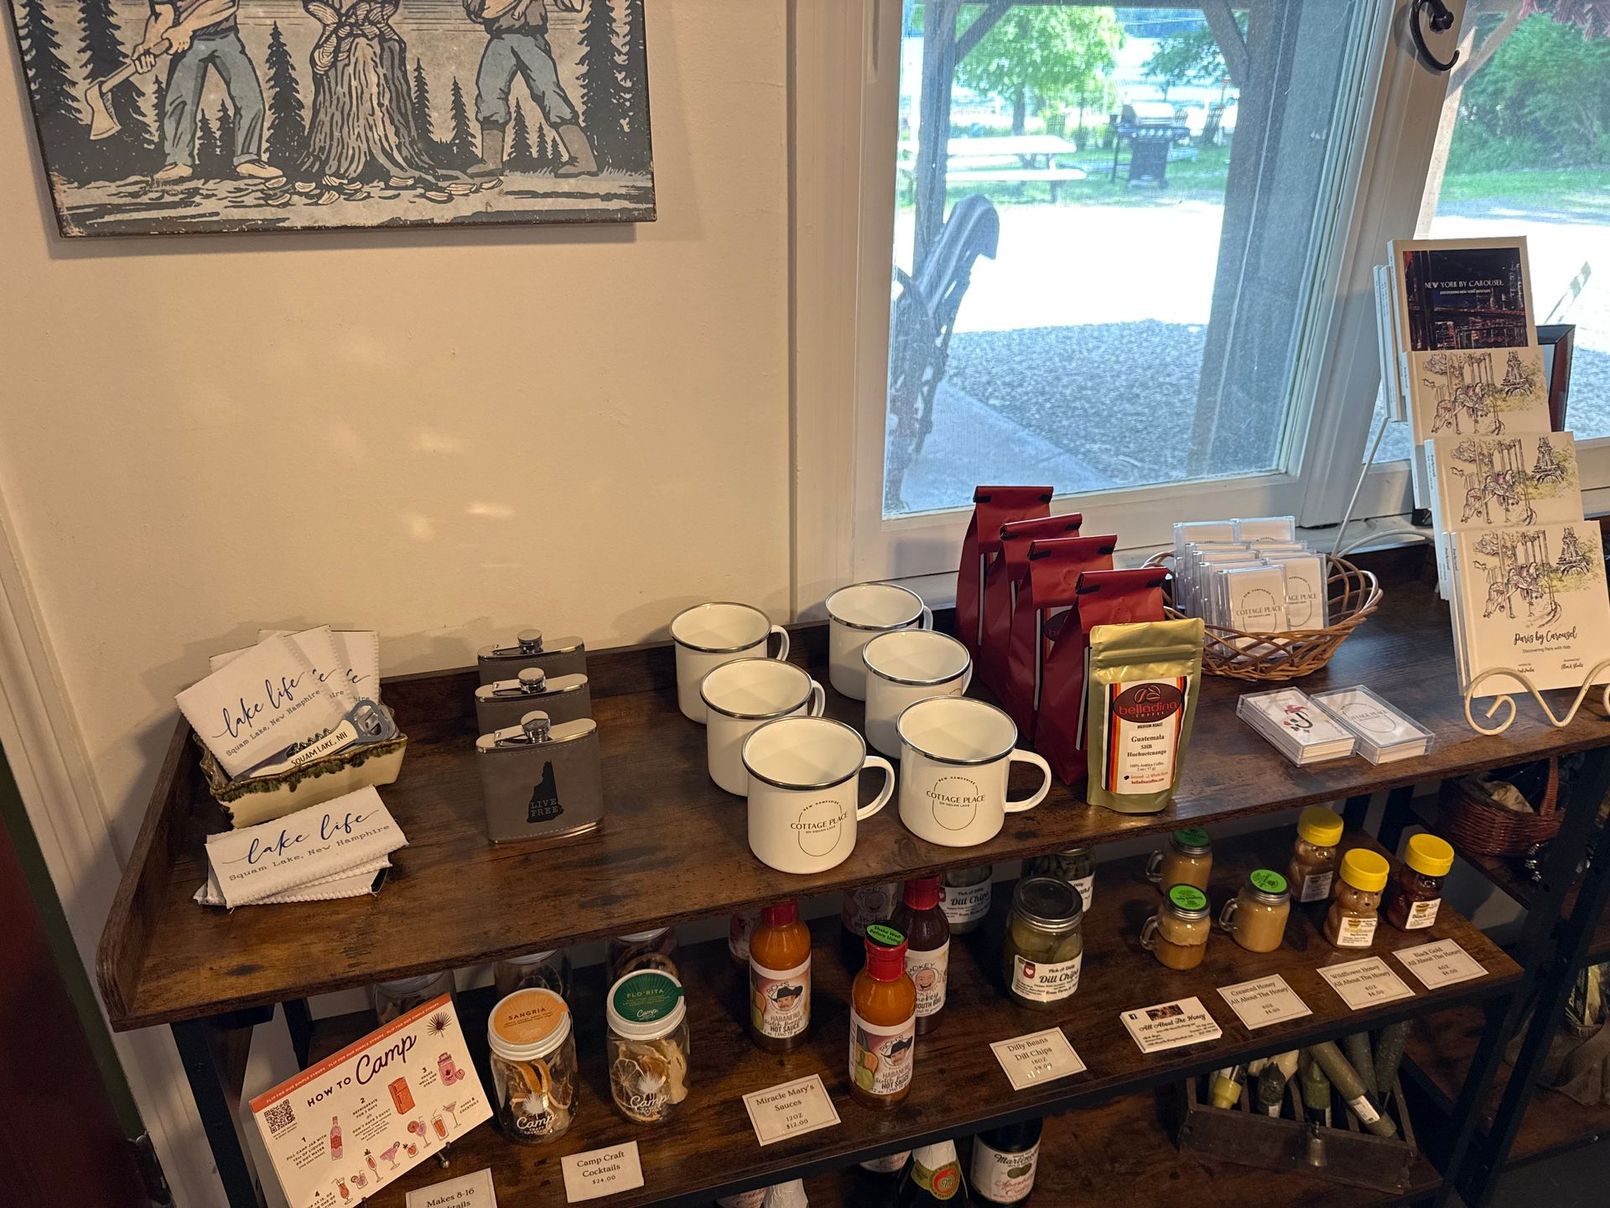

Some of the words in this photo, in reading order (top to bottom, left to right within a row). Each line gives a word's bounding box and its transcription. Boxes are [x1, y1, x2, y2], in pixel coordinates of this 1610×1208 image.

[1236, 607, 1262, 616] COTTAGE
[1514, 632, 1534, 646] Paris
[1536, 631, 1544, 645] by
[1546, 626, 1577, 642] Carousel
[212, 698, 263, 738] lake
[265, 672, 305, 709] life
[226, 743, 248, 757] Squam
[250, 726, 270, 741] Lake,
[270, 714, 285, 727] New
[1131, 734, 1164, 742] Guatemala
[530, 798, 557, 808] LIVE
[926, 790, 960, 803] COTTAGE
[963, 795, 984, 803] PLACE
[531, 806, 560, 817] FREE
[790, 820, 827, 830] COTTAGE
[829, 810, 848, 826] PLACE
[222, 830, 310, 864] lake
[320, 810, 379, 840] life
[229, 864, 267, 881] Squam
[273, 854, 304, 868] Lake,
[308, 844, 331, 857] New
[951, 898, 967, 906] Dill
[1040, 975, 1058, 983] Dill
[1059, 968, 1079, 981] Chips
[1257, 982, 1276, 990] Honey
[508, 1008, 546, 1020] SANGRIA
[636, 1008, 658, 1018] Camp
[783, 1022, 800, 1032] SAUCE
[1008, 1042, 1026, 1052] Dilly
[1026, 1037, 1048, 1047] Beans
[1014, 1052, 1030, 1060] Dill
[1030, 1046, 1052, 1057] Chips
[306, 1087, 334, 1108] HOW
[336, 1077, 352, 1090] TO
[356, 1034, 417, 1085] Camp
[756, 1092, 786, 1106] Miracle
[788, 1084, 814, 1097] Mary's
[630, 1094, 670, 1112] Camp
[774, 1100, 802, 1112] Sauces
[516, 1114, 558, 1132] Camp
[786, 1118, 808, 1130] $12.00
[576, 1158, 602, 1168] Camp
[604, 1151, 624, 1162] Craft
[582, 1164, 620, 1177] Cocktails
[592, 1175, 616, 1184] $24.00
[426, 1194, 454, 1207] Makes
[456, 1187, 474, 1199] 8-16
